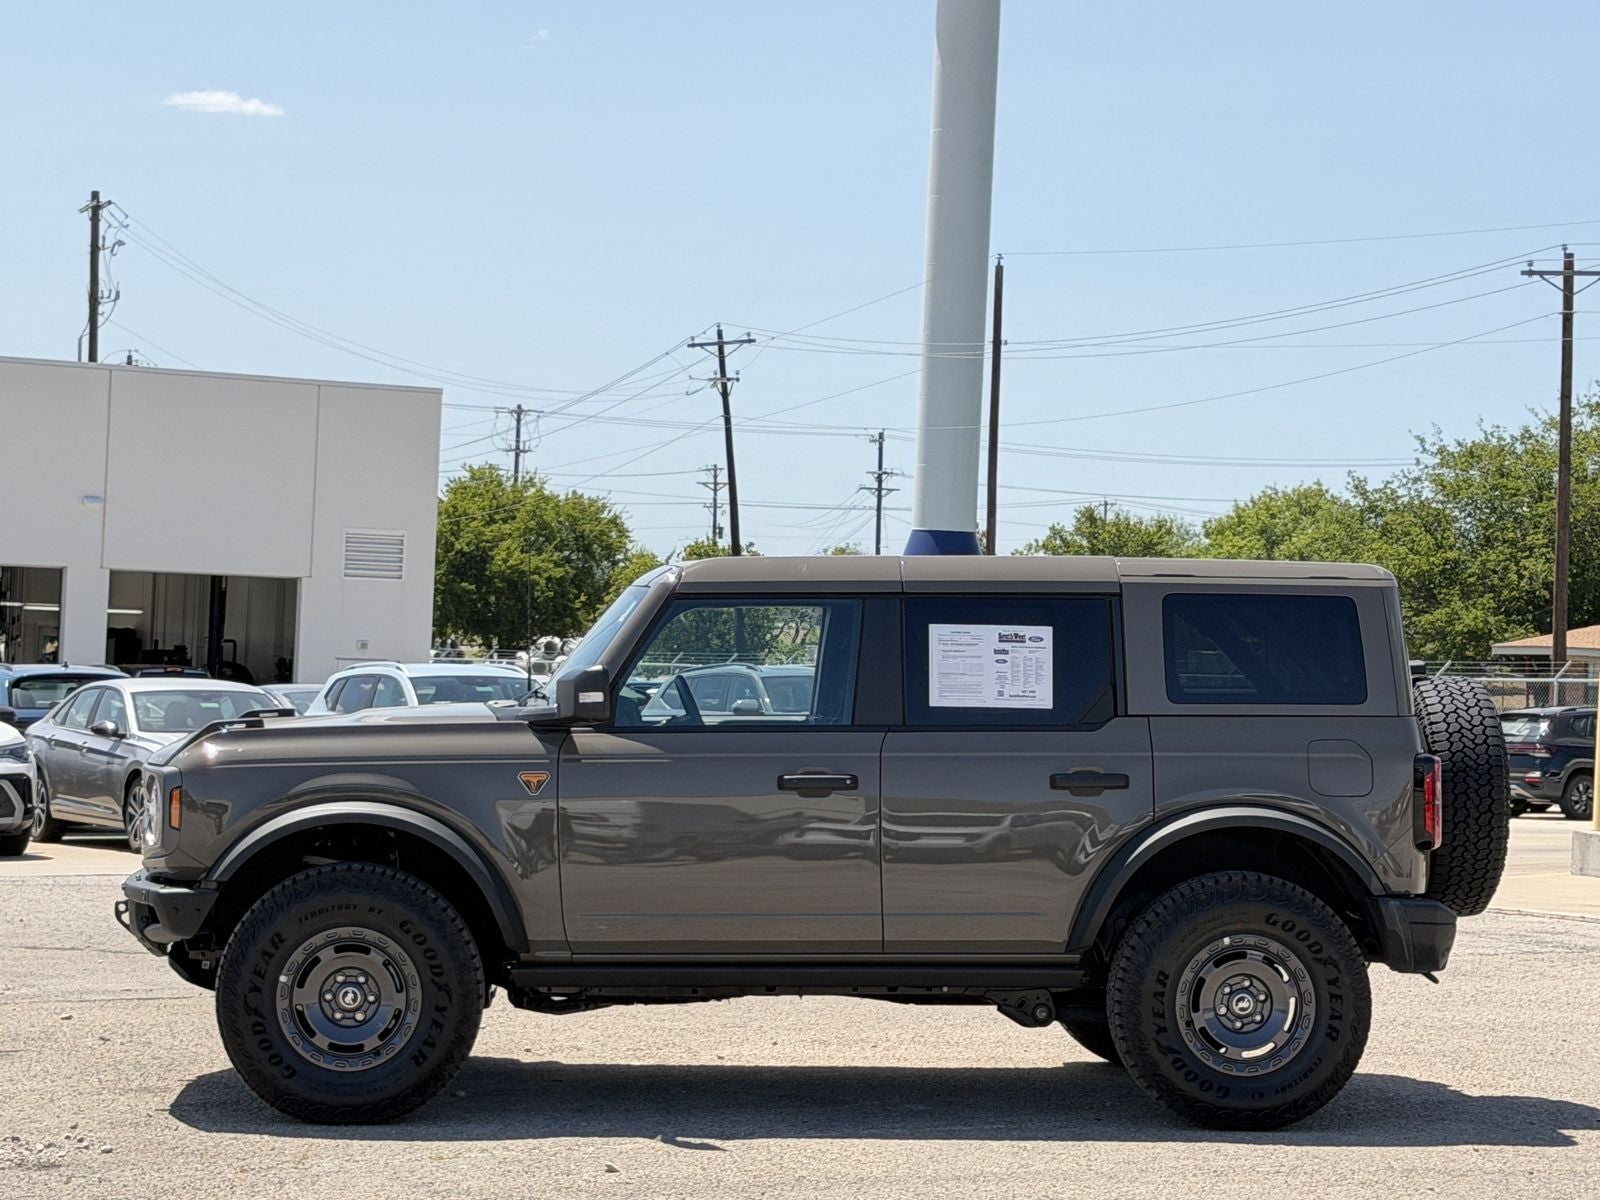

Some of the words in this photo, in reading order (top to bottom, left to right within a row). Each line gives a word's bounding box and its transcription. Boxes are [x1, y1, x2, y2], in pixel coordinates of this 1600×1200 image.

[298, 904, 358, 924] TERRITORY
[1264, 912, 1344, 1043] GOODYEAR
[243, 930, 297, 1080] GOODYEAR
[399, 918, 453, 1068] GOODYEAR
[1152, 970, 1231, 1099] GOODYEAR
